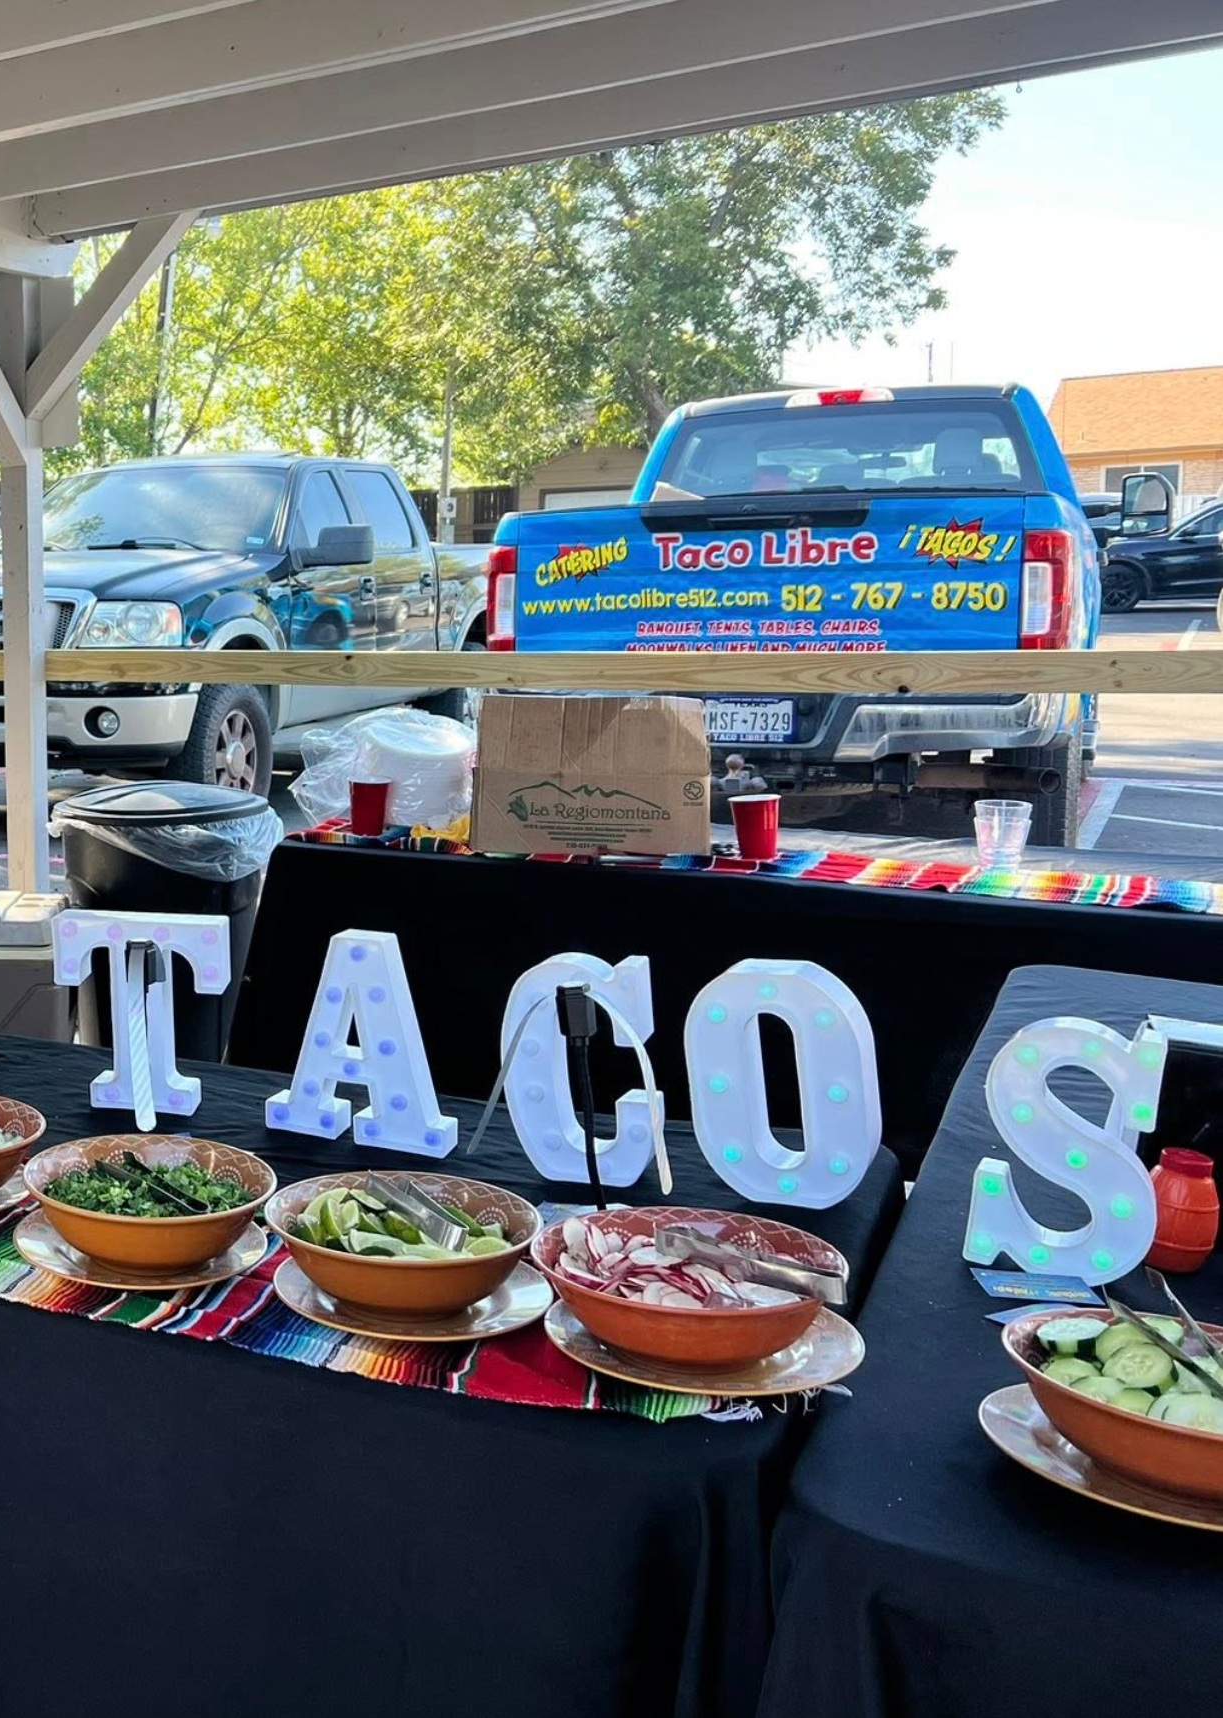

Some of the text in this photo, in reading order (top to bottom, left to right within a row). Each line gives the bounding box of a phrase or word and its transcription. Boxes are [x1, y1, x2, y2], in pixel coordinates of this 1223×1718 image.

[535, 536, 628, 588] CATERING
[653, 527, 878, 571] Taco Libre
[522, 588, 769, 616] www.tacolibre512.com
[781, 583, 824, 611] 512
[850, 581, 904, 610] 767
[930, 581, 1007, 611] 8750
[636, 618, 883, 638] BANQUET, TENTS, TABLES, CHAIRS,
[529, 801, 671, 822] La Regiomontana
